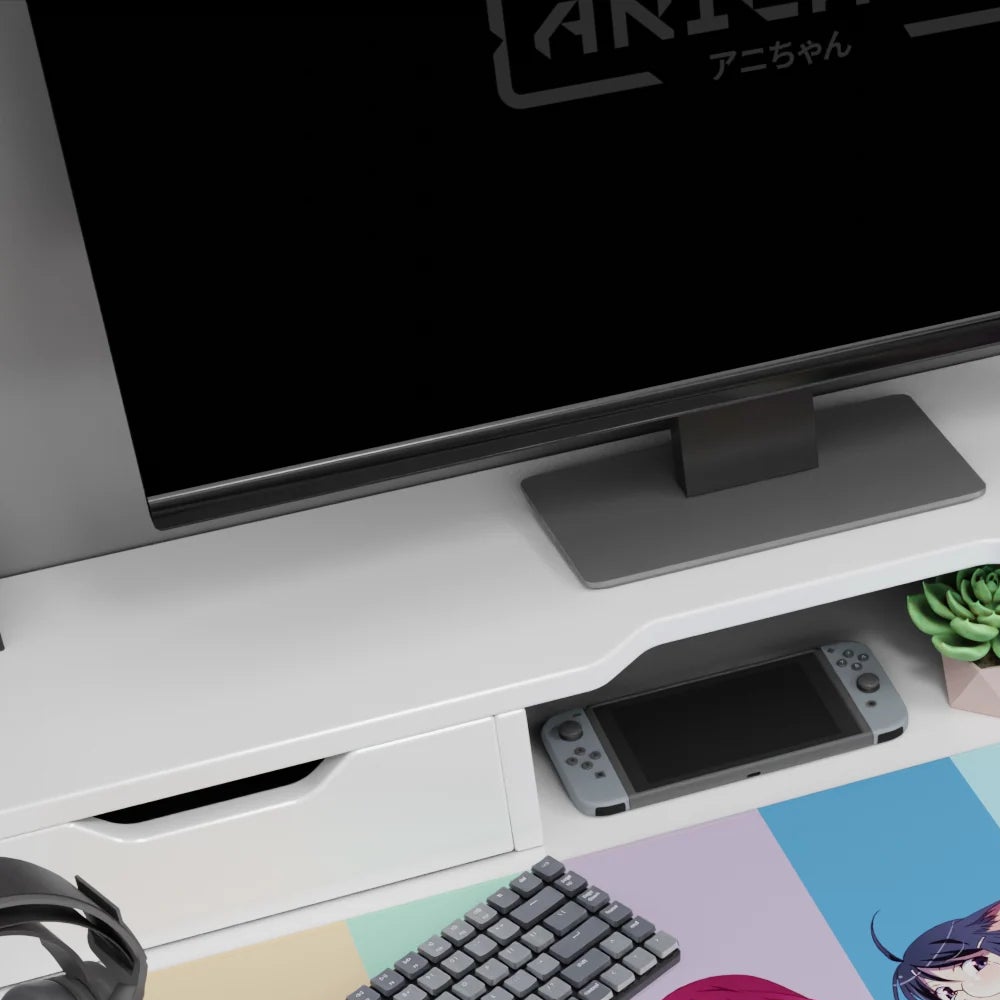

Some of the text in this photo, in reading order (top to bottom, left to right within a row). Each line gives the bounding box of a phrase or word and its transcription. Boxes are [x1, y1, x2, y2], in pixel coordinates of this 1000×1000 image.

[709, 31, 852, 80] アニちゃん
